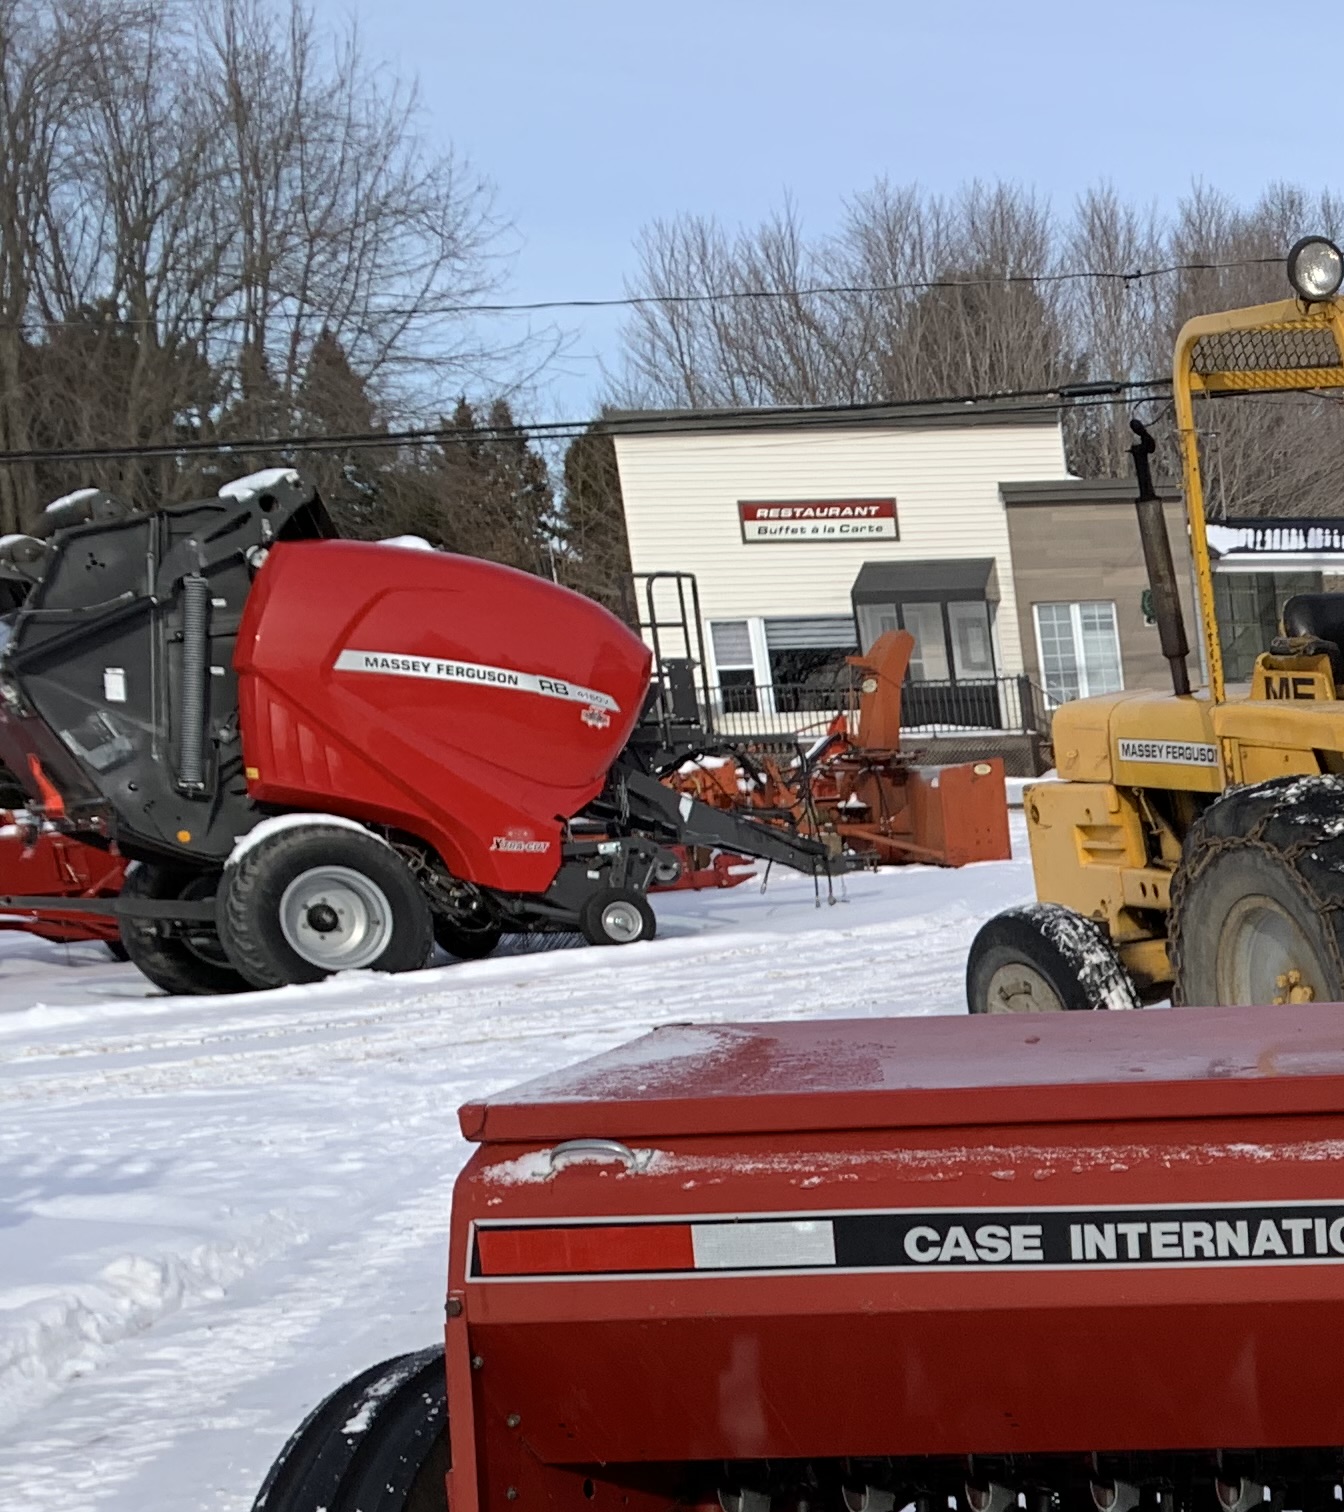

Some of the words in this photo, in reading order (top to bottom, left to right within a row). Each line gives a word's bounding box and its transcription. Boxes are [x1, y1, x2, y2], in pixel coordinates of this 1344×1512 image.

[756, 506, 880, 519] RESTAURANT
[757, 525, 807, 535] Buffet
[823, 525, 835, 533] la
[839, 524, 883, 534] Carte
[364, 656, 431, 673] MASSEY
[436, 663, 519, 686] FERGUSON
[538, 679, 569, 696] RB
[1121, 743, 1165, 759] MASSEY
[903, 1224, 1044, 1262] CASE
